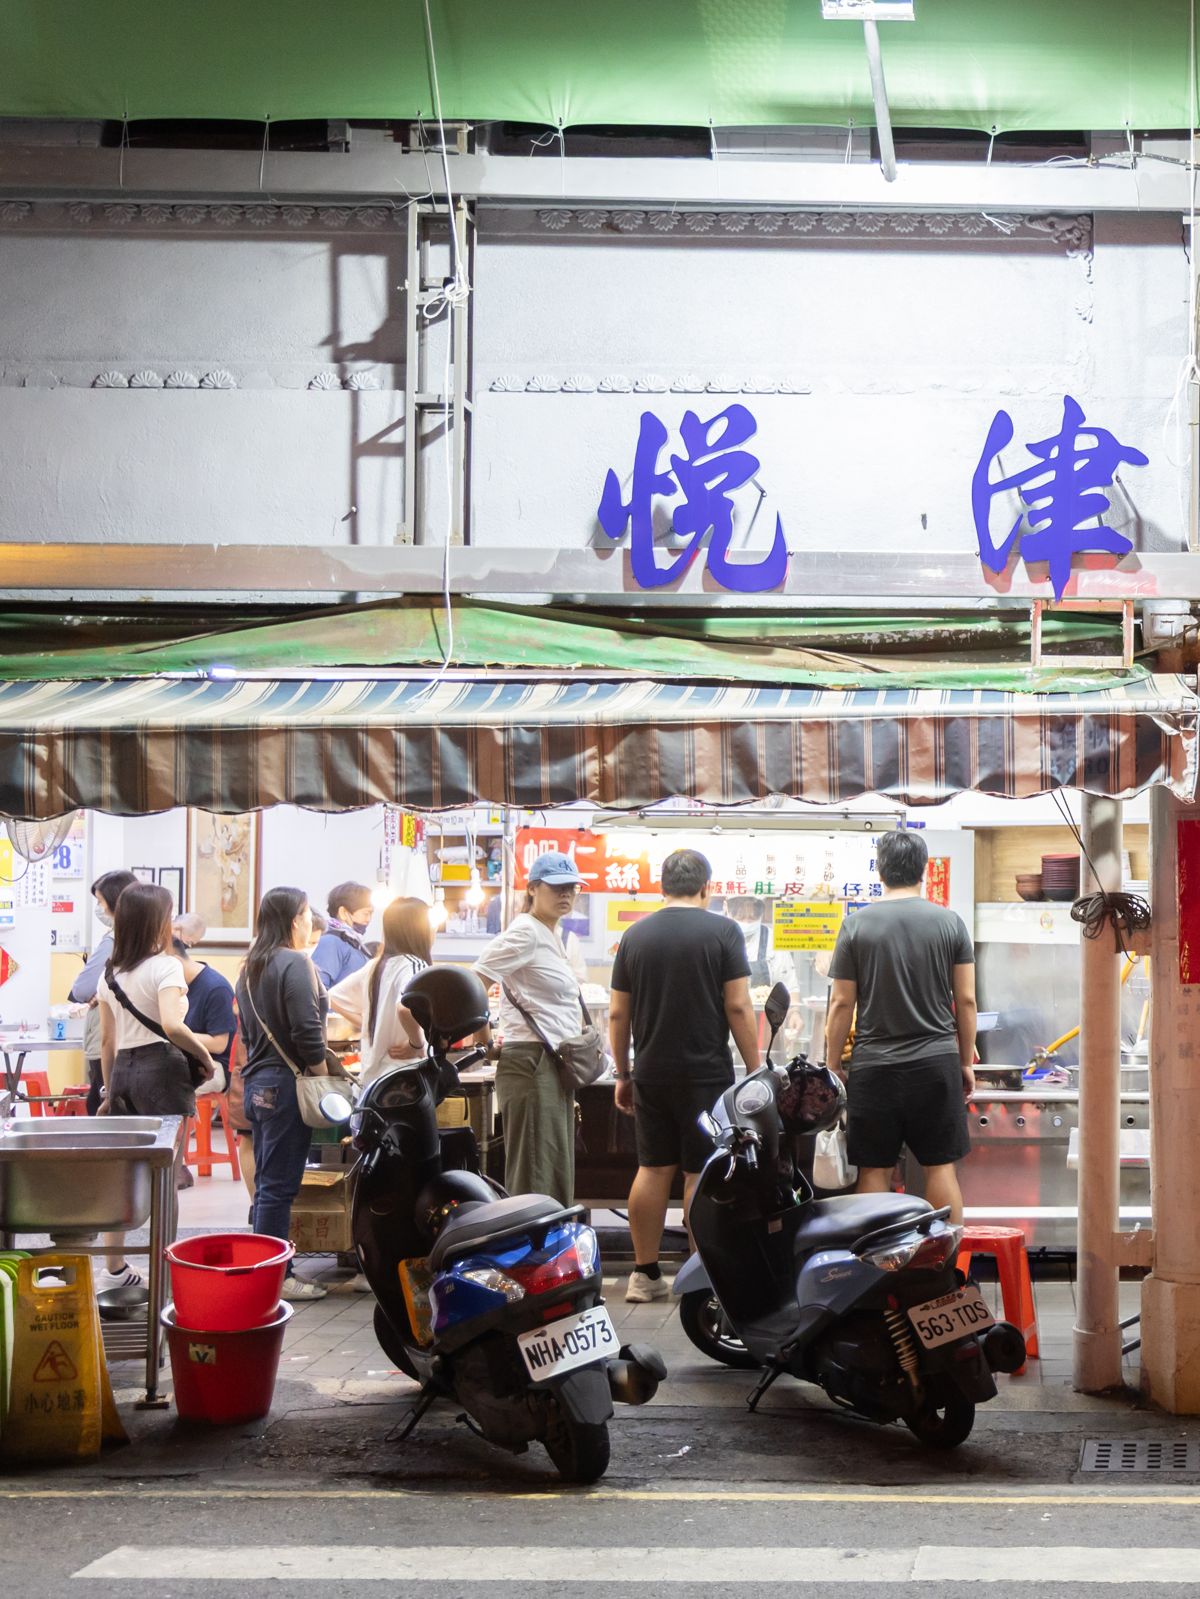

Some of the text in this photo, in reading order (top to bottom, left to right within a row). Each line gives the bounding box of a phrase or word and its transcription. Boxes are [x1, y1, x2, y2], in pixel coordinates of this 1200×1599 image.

[35, 1312, 75, 1322] CAUTION
[30, 1320, 79, 1332] WET FLOOR
